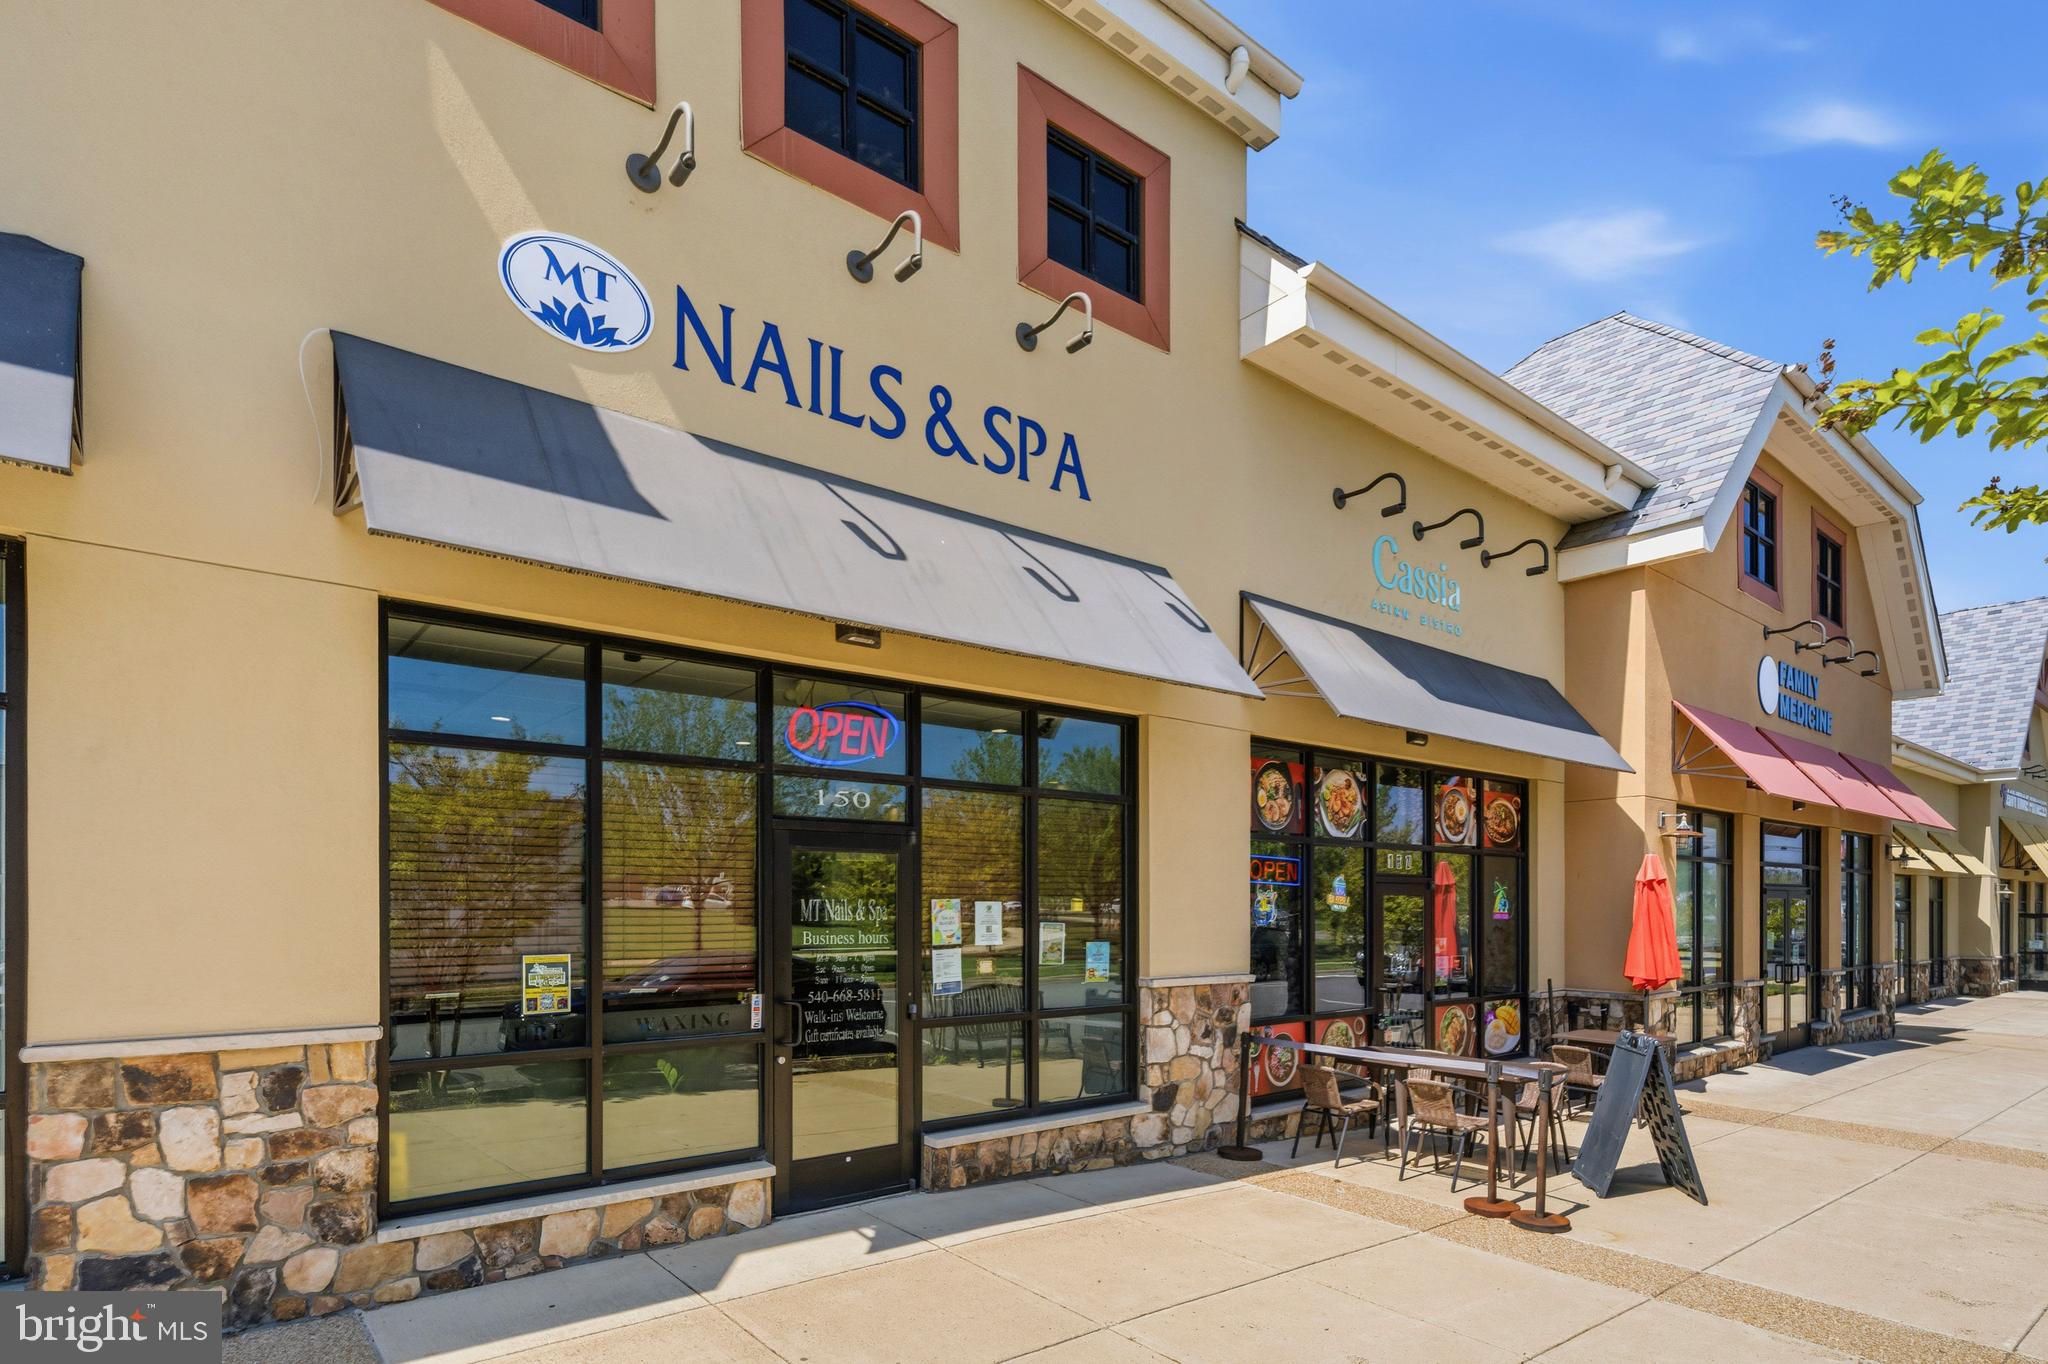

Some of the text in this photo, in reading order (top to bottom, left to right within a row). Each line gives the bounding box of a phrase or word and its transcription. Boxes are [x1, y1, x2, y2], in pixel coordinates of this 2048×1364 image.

[539, 244, 617, 303] MT
[672, 284, 1092, 502] NAILS & SPA
[1372, 535, 1461, 613] Cassia
[1778, 661, 1818, 701] FAMILY
[1778, 692, 1832, 736] MEDICINE
[787, 706, 889, 758] OPEN
[814, 789, 871, 809] 150
[1250, 859, 1297, 881] OPEN
[800, 899, 888, 927] MT Nails & Spa
[803, 930, 889, 945] Business hours
[808, 989, 881, 1004] 540-668-5811
[635, 1011, 729, 1031] WAXING
[804, 1008, 884, 1024] Walk-ins Welcome
[805, 1028, 819, 1043] Gift
